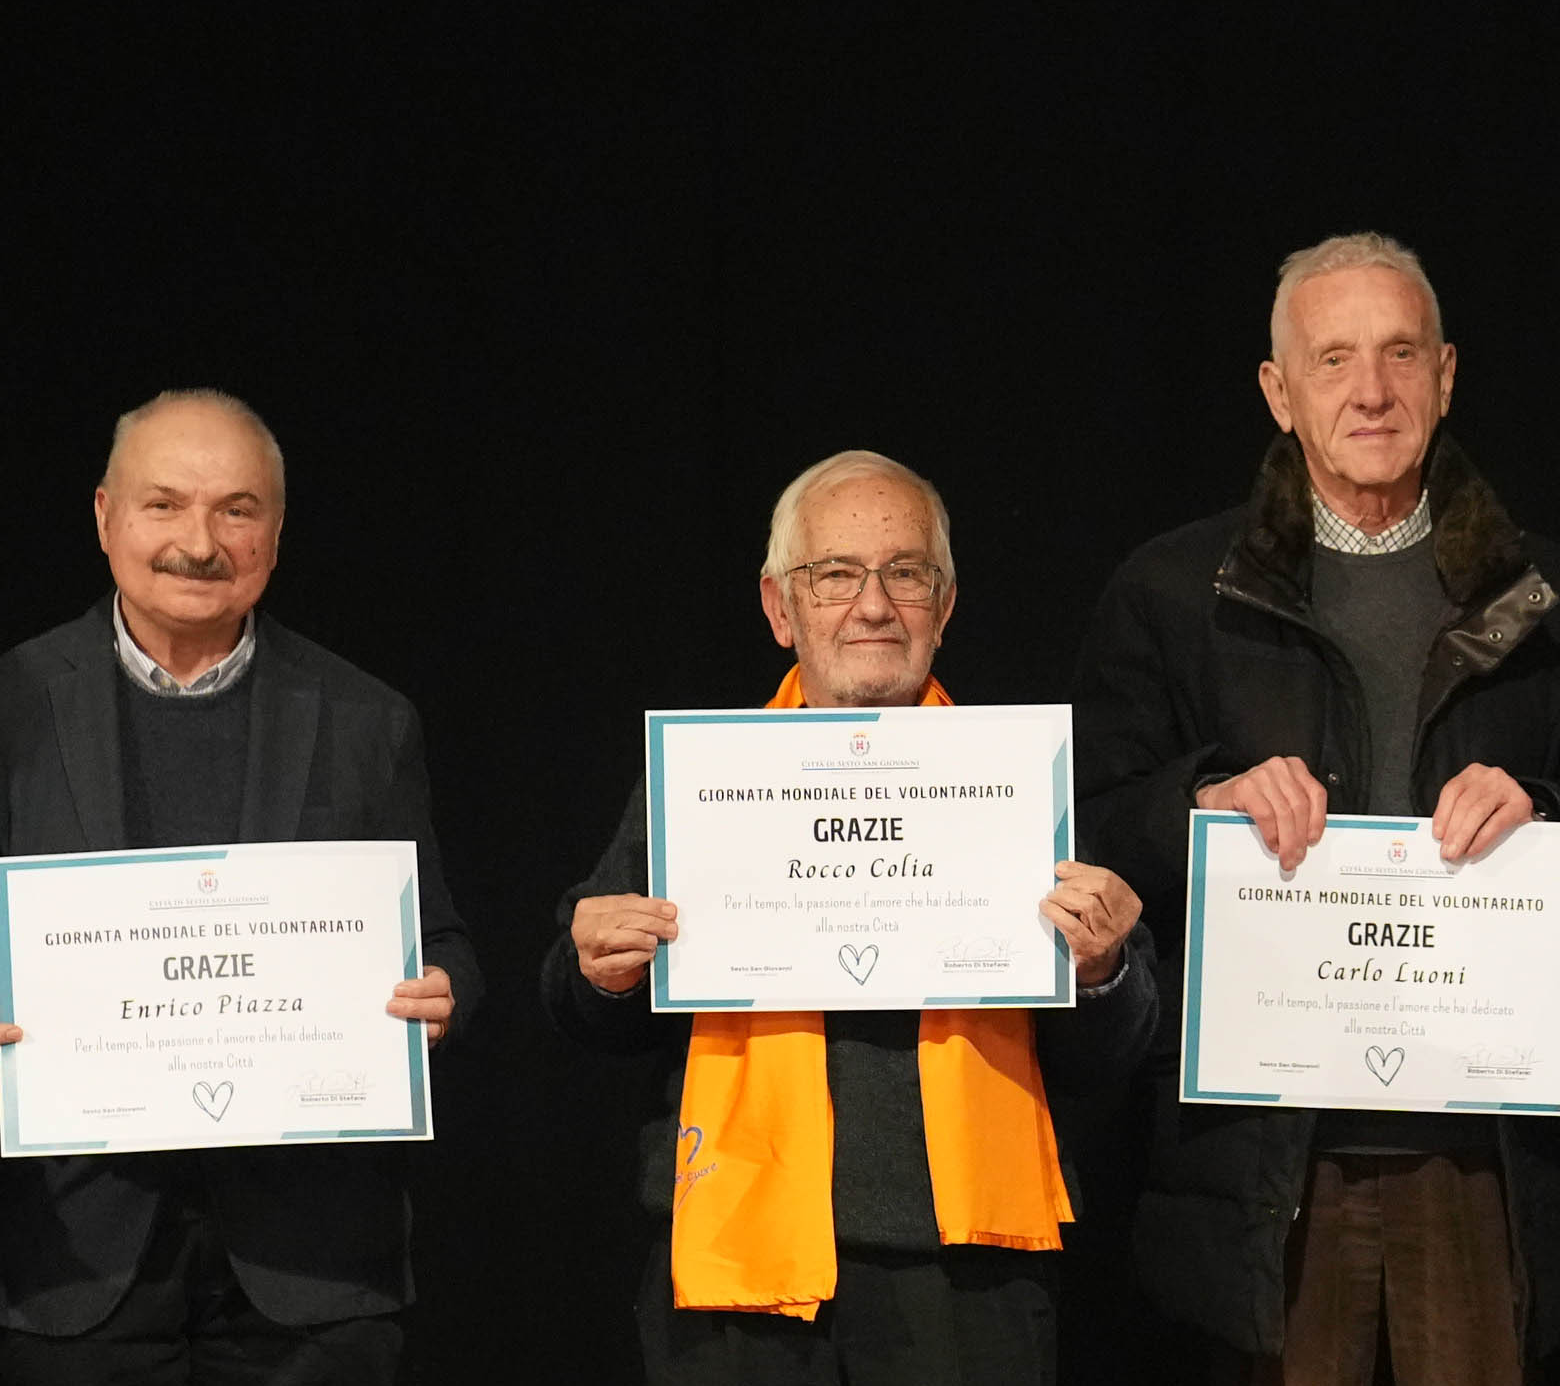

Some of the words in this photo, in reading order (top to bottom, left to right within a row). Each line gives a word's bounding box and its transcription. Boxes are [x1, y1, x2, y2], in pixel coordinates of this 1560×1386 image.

[698, 788, 774, 802] GIORNATA
[781, 787, 857, 801] MONDIALE
[864, 786, 892, 800] DEL
[898, 784, 1014, 800] VOLONTARIATO
[813, 817, 904, 843] GRAZIE
[787, 859, 856, 879] Rocco
[870, 852, 934, 878] Colia
[1238, 887, 1312, 903] GIORNATA
[1318, 890, 1393, 907] MONDIALE
[1399, 893, 1425, 908] DEL
[1432, 895, 1544, 912] VOLONTARIATO
[45, 929, 122, 946] GIORNATA
[129, 924, 206, 942] MONDIALE
[214, 923, 241, 937] DEL
[248, 919, 364, 935] VOLONTARIATO
[1347, 921, 1435, 949] GRAZIE
[162, 953, 256, 981] GRAZIE
[1317, 957, 1383, 982] Carlo
[1394, 961, 1466, 985] Luoni
[120, 997, 203, 1020] Enrico
[218, 994, 304, 1014] Piazza
